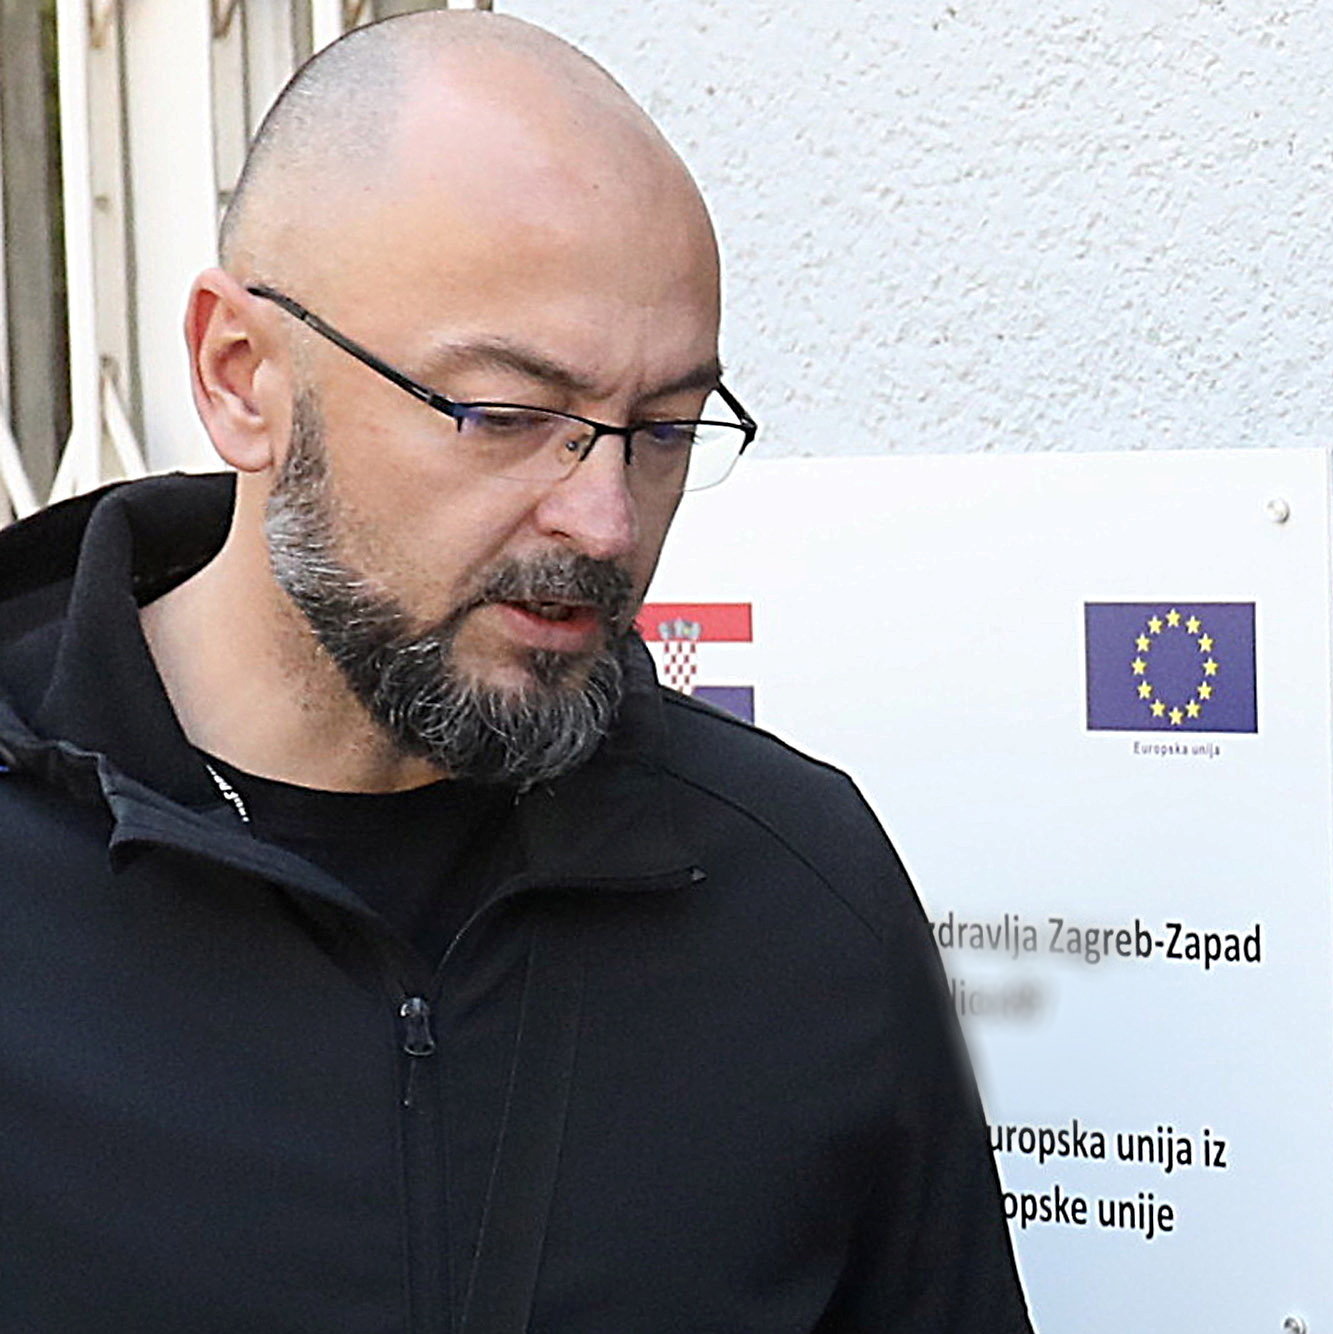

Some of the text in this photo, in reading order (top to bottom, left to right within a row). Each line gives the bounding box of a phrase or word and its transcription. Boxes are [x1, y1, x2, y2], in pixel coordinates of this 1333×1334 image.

[1133, 741, 1221, 759] Europska unija
[1047, 919, 1262, 971] Zagreb-Zapad
[987, 1119, 1228, 1174] uropska unija iz
[1002, 1185, 1174, 1240] opske unije
